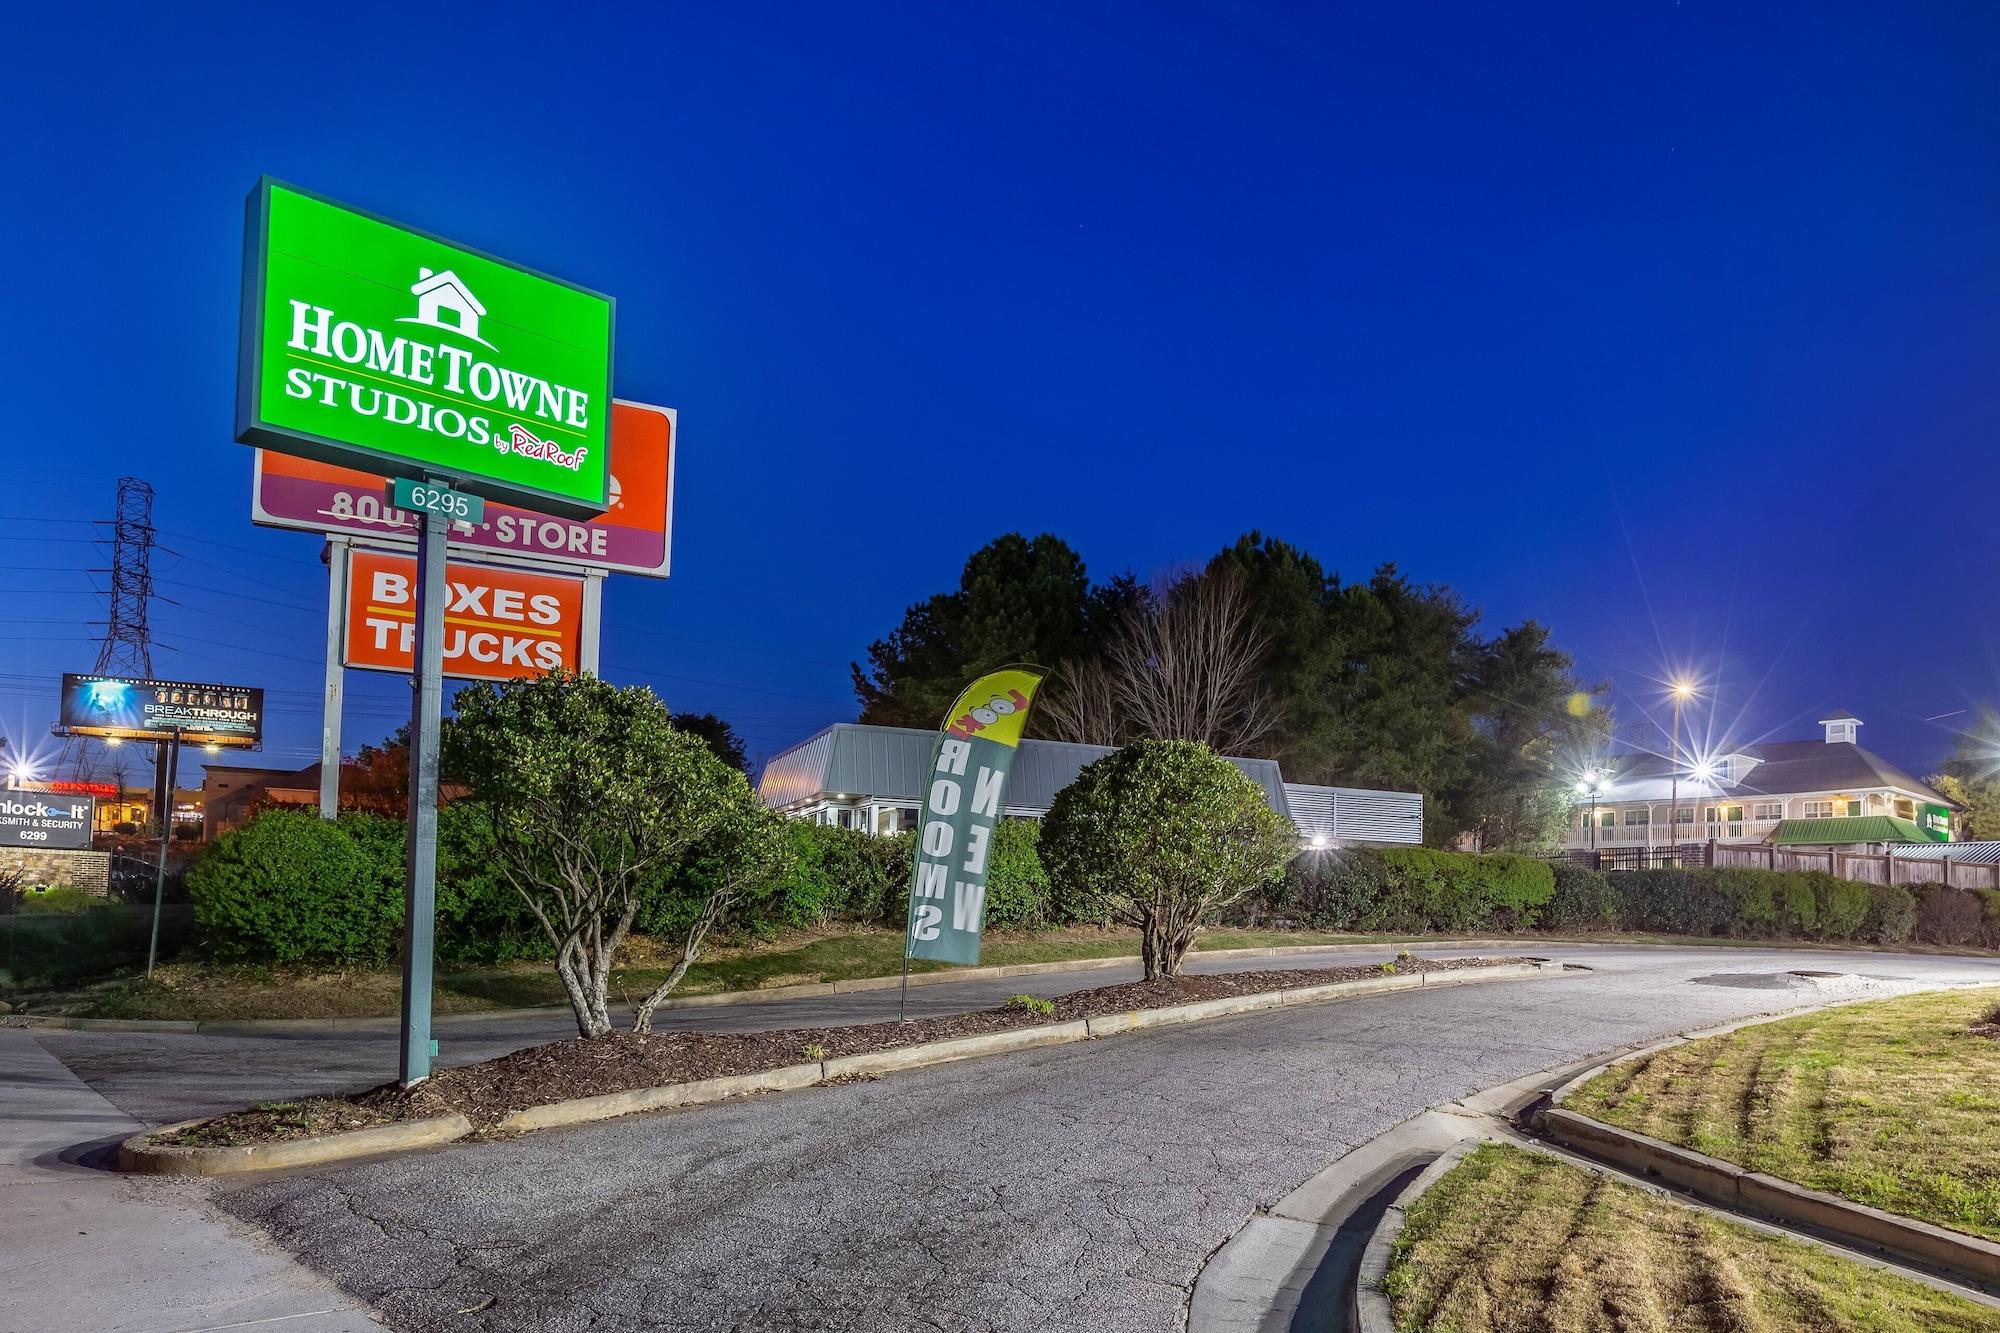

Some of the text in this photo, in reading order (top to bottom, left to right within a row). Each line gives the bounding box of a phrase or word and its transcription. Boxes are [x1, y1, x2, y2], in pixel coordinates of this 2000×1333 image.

[285, 368, 490, 445] STUDIOS
[494, 434, 509, 453] by
[411, 487, 468, 517] 6295
[144, 704, 257, 721] BREAKTHROUGH
[32, 819, 39, 827] &
[41, 819, 84, 829] SECURITY
[20, 830, 47, 840] 6299
